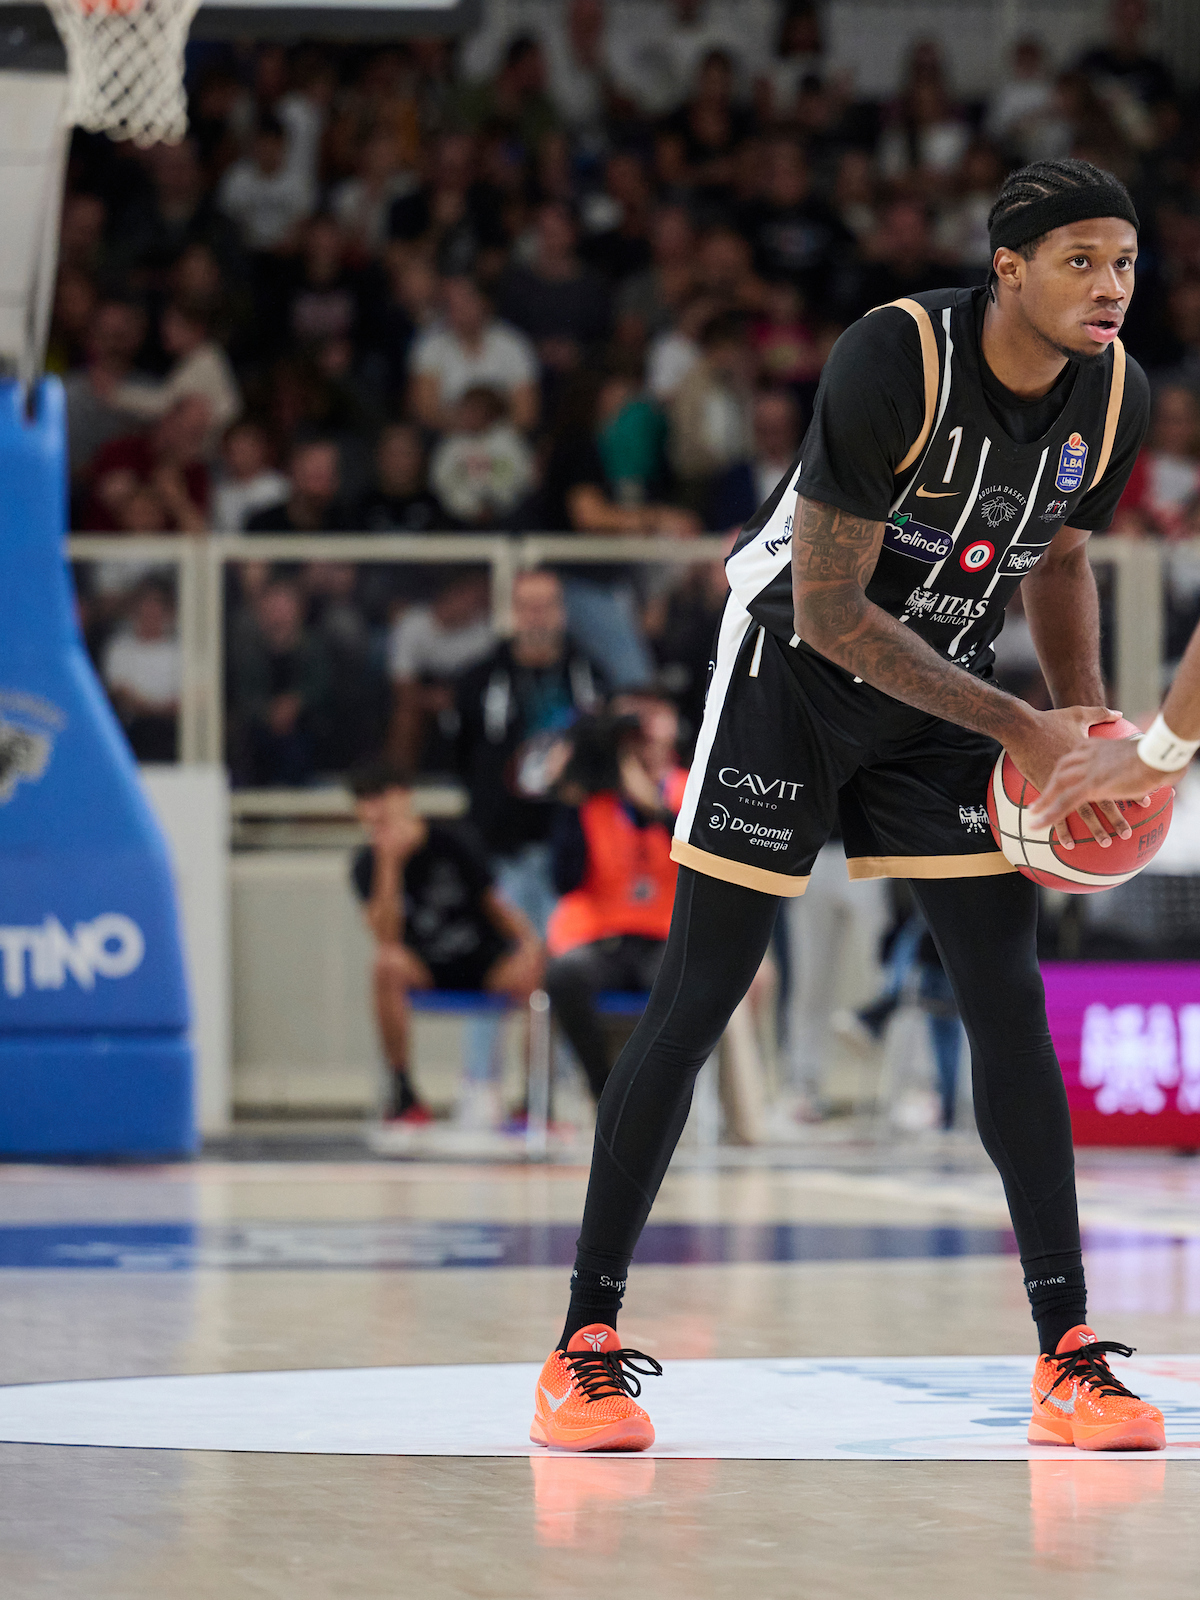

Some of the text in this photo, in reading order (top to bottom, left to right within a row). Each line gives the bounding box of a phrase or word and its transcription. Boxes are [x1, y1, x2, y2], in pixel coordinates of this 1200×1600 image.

[942, 426, 963, 483] 1
[1063, 457, 1082, 469] LBA
[978, 485, 1027, 506] AQUILA BASKET
[936, 594, 989, 619] ITAS
[929, 613, 967, 627] MUTUA
[718, 767, 804, 801] CAVIT
[738, 796, 778, 811] TRENTO
[730, 817, 794, 841] Dolomiti
[1138, 822, 1164, 851] FIBA
[749, 837, 789, 852] energia
